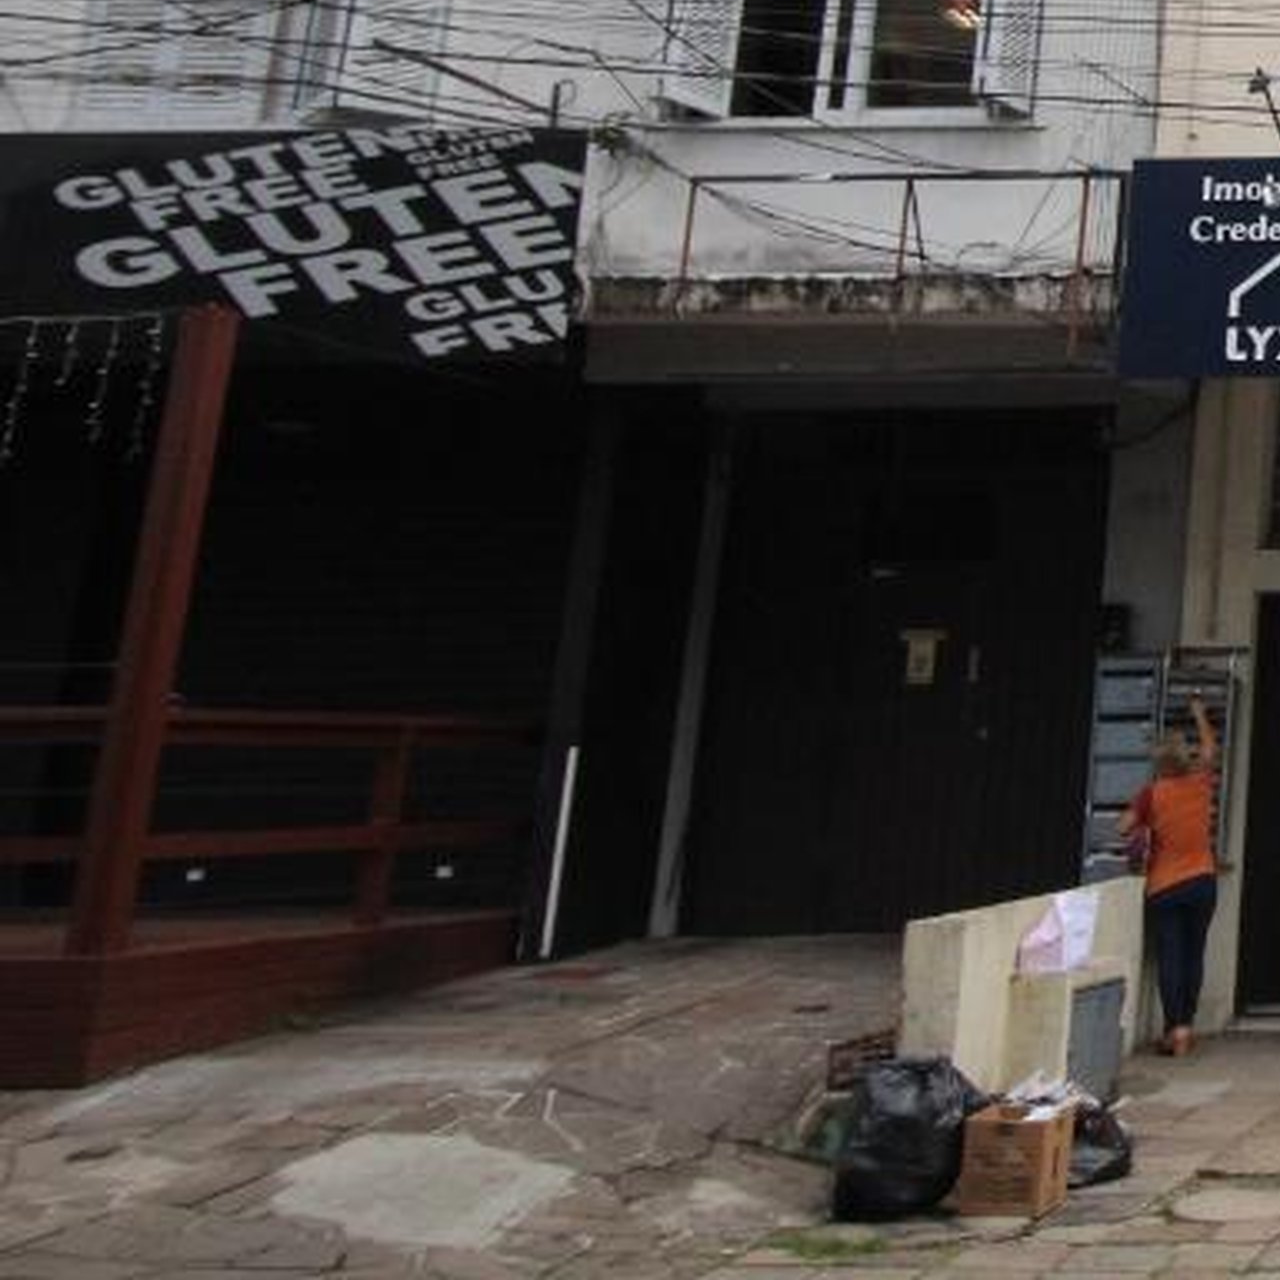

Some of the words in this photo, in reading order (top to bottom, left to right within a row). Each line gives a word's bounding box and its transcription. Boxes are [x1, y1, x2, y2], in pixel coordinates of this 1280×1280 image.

[52, 126, 420, 209] GLUTEN
[131, 161, 368, 231] FREE
[221, 213, 572, 318] FREE
